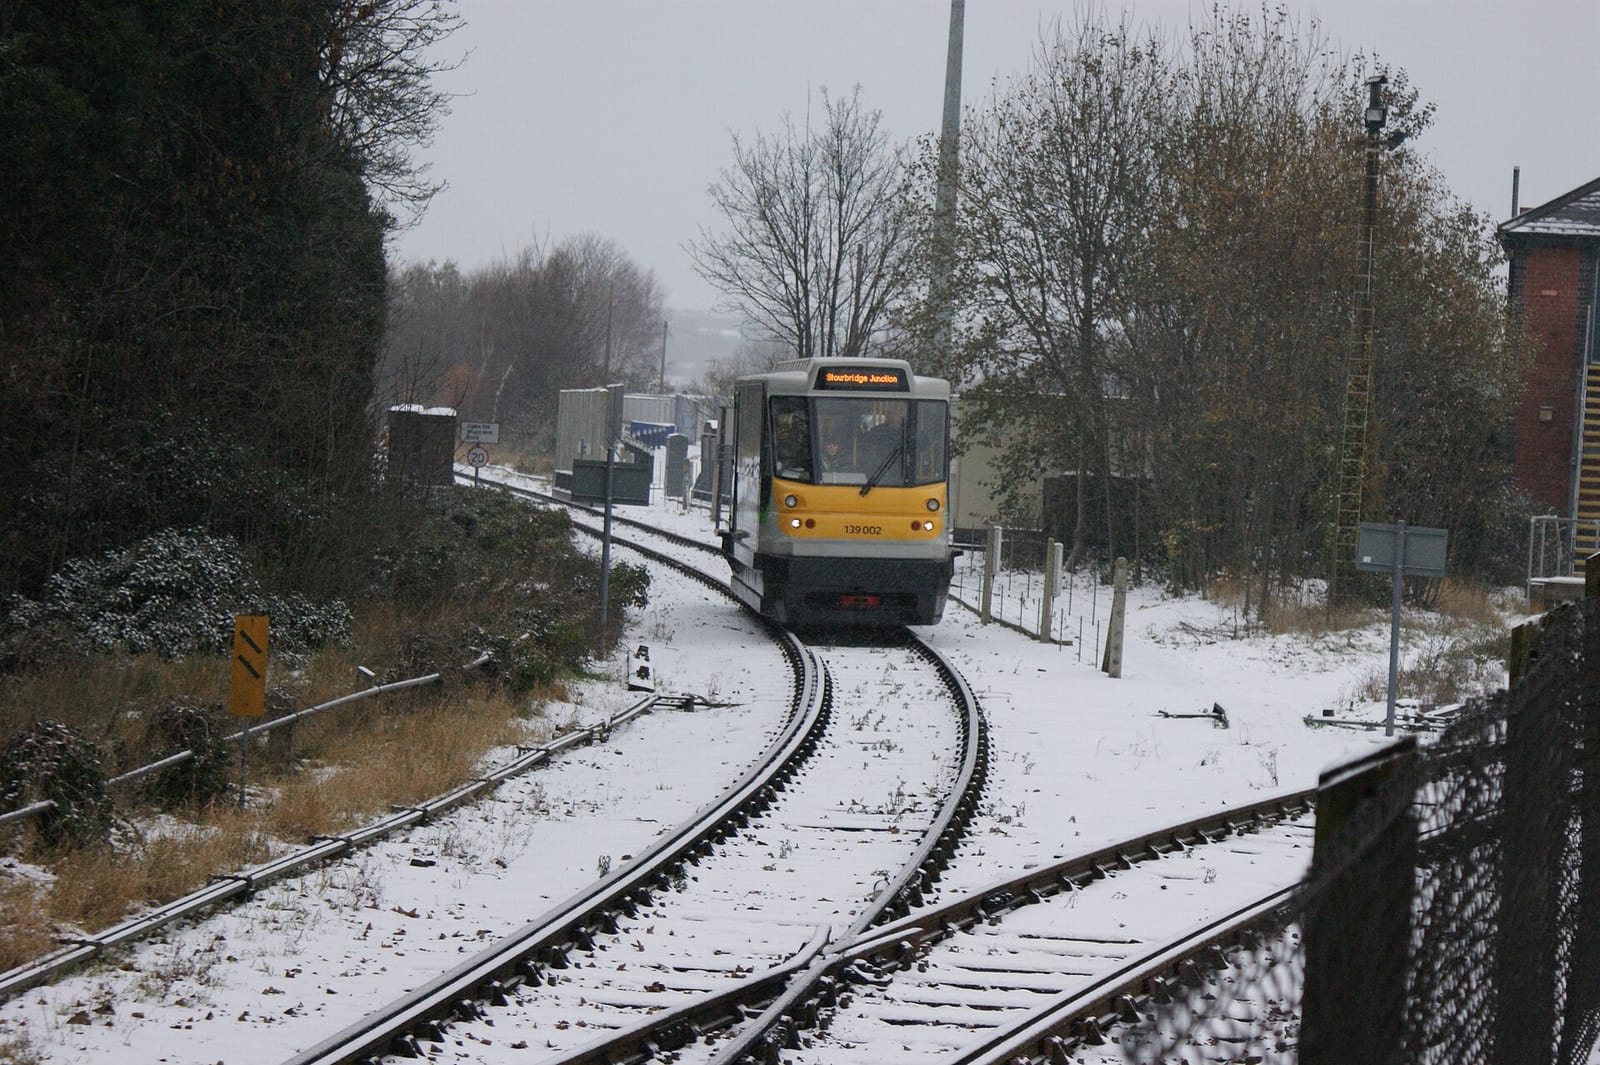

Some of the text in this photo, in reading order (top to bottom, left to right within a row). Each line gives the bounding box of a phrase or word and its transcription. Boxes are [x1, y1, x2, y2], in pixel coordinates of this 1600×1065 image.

[826, 373, 898, 383] Stourbridge Junction
[471, 453, 484, 463] 20
